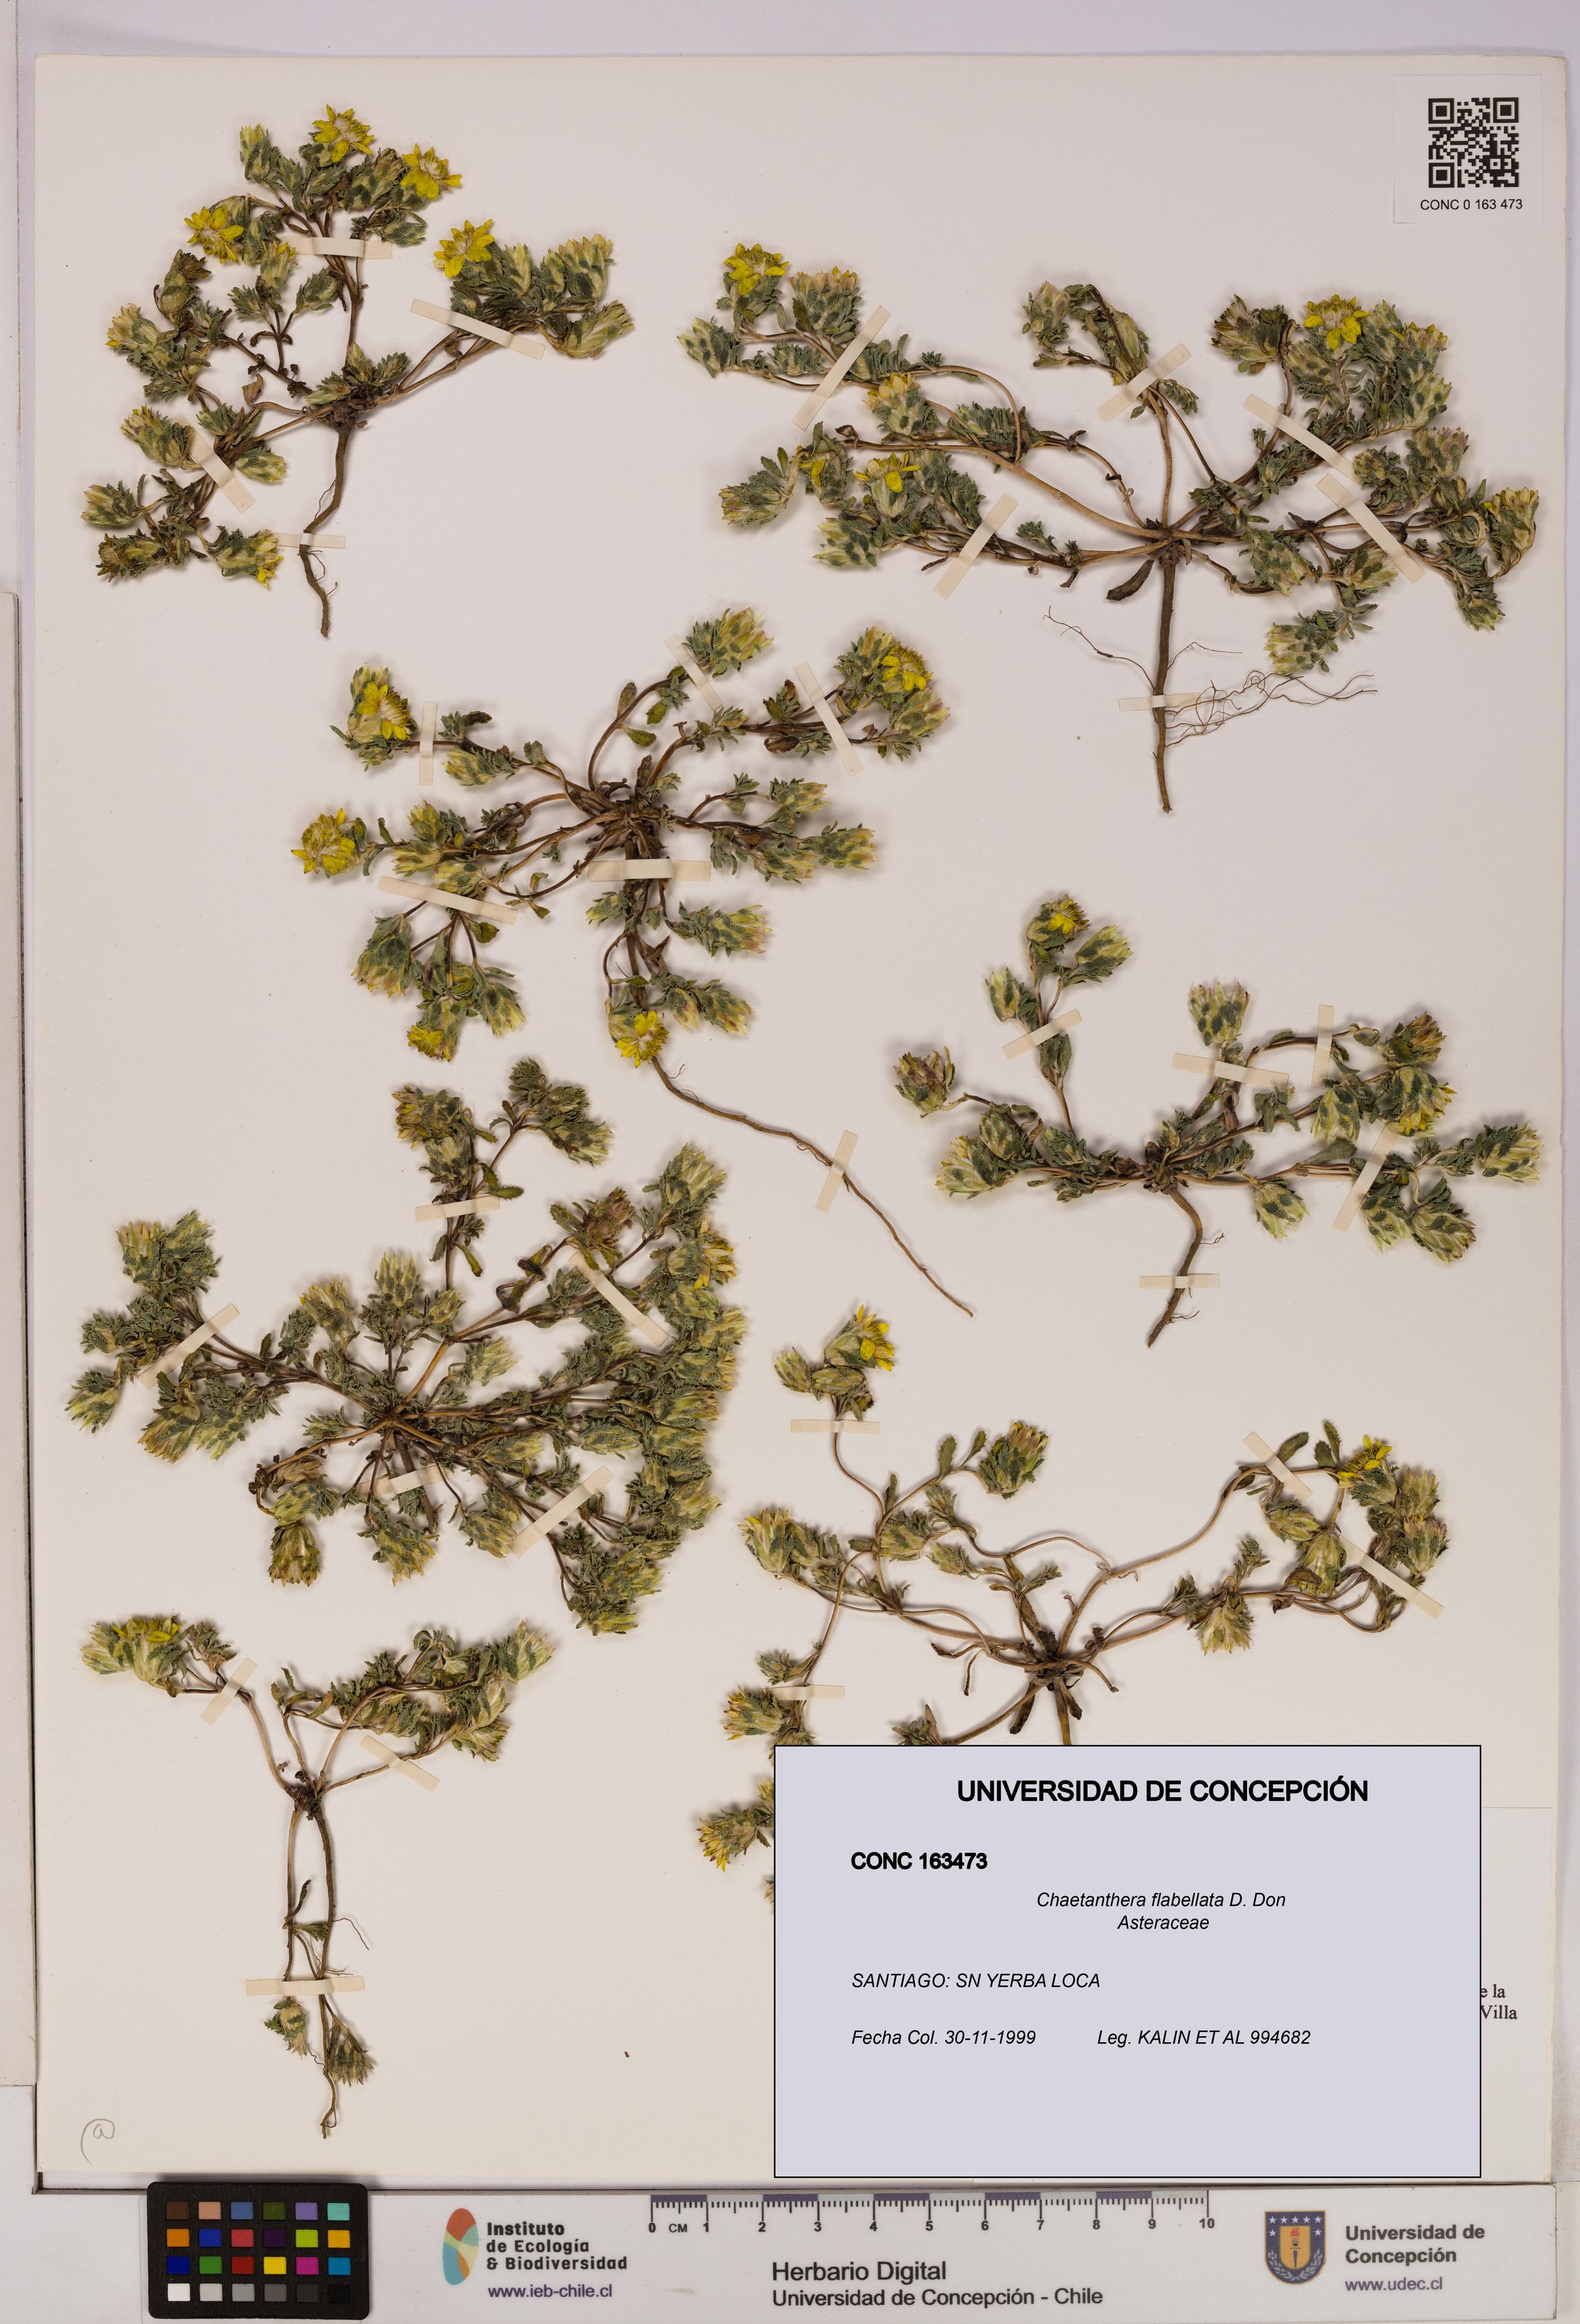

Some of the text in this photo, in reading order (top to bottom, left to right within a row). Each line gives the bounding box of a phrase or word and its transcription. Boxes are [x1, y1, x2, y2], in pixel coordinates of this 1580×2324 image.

[1420, 199, 1523, 211] CONC 0 163 473
[1492, 1983, 1507, 1999] la
[1481, 2004, 1518, 2020] Villa
[487, 2221, 565, 2236] Instituto
[648, 2218, 1215, 2233] 0 CM 1 2 3 4 5 6 7 8 9 10
[1345, 2224, 1485, 2241] Universidad de
[485, 2238, 589, 2255] de Ecología
[486, 2255, 627, 2270] & Biodiversidad
[1345, 2247, 1457, 2267] Concepción
[772, 2260, 946, 2284] Herbario Digital
[487, 2284, 612, 2298] www.ieb-chile.cl
[1344, 2276, 1443, 2291] www.udec.cl
[772, 2289, 885, 2306] Universidad
[891, 2289, 915, 2306] de
[921, 2288, 1035, 2309] Concepción
[1054, 2287, 1103, 2304] Chile
